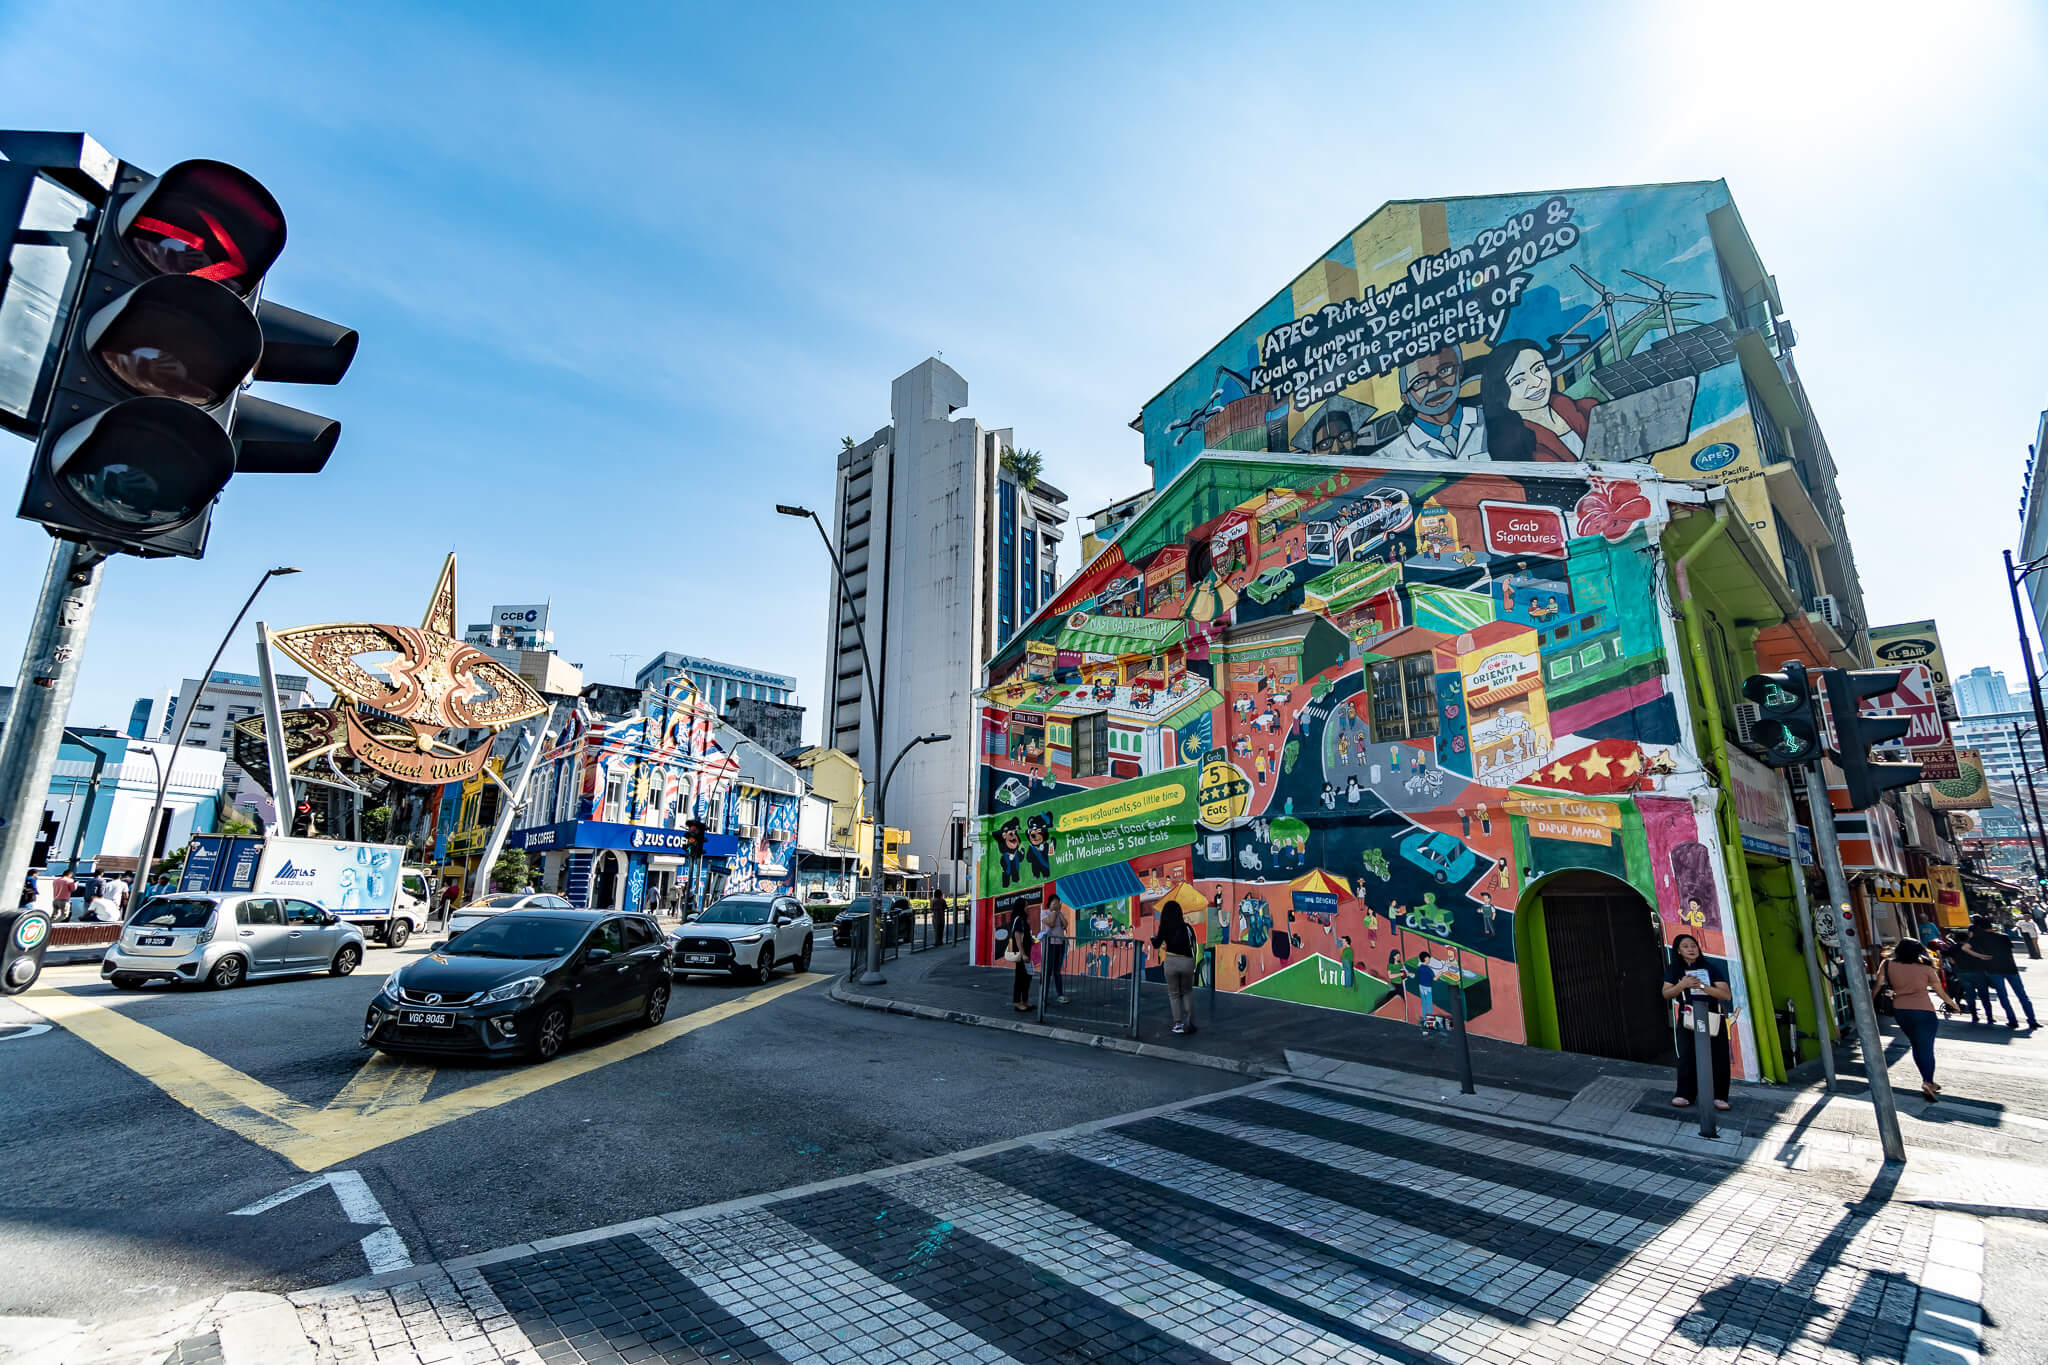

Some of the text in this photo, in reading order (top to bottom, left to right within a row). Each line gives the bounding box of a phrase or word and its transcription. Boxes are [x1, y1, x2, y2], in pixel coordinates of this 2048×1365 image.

[1265, 200, 1569, 359] APEC Putrajaya Vision 2040 &
[1251, 226, 1576, 391] Kuala Lumpur Declaration 2020
[1385, 299, 1481, 349] Principle
[1295, 358, 1371, 408] Shared
[1701, 449, 1730, 464] APEC
[1508, 518, 1539, 532] Grab
[1496, 530, 1557, 544] Signatures
[500, 612, 524, 621] CCB
[692, 661, 786, 686] BANGKOK BANK
[1473, 661, 1527, 685] ORIENTAL
[356, 742, 474, 779] Kasturi Walk
[1207, 752, 1222, 762] Grab
[1209, 766, 1220, 784] 5
[1143, 794, 1160, 807] little
[1162, 790, 1179, 801] time
[1207, 803, 1228, 816] Eats
[1520, 800, 1553, 815] NASI
[538, 830, 556, 844] COFFEE
[644, 832, 665, 847] ZUS
[1066, 832, 1085, 848] Find
[1086, 830, 1100, 842] the
[1100, 826, 1120, 840] best
[1055, 830, 1169, 864] with Malaysia's 5 Star Eats
[1880, 880, 1930, 898] ATM
[408, 1012, 446, 1024] VGC 9045
